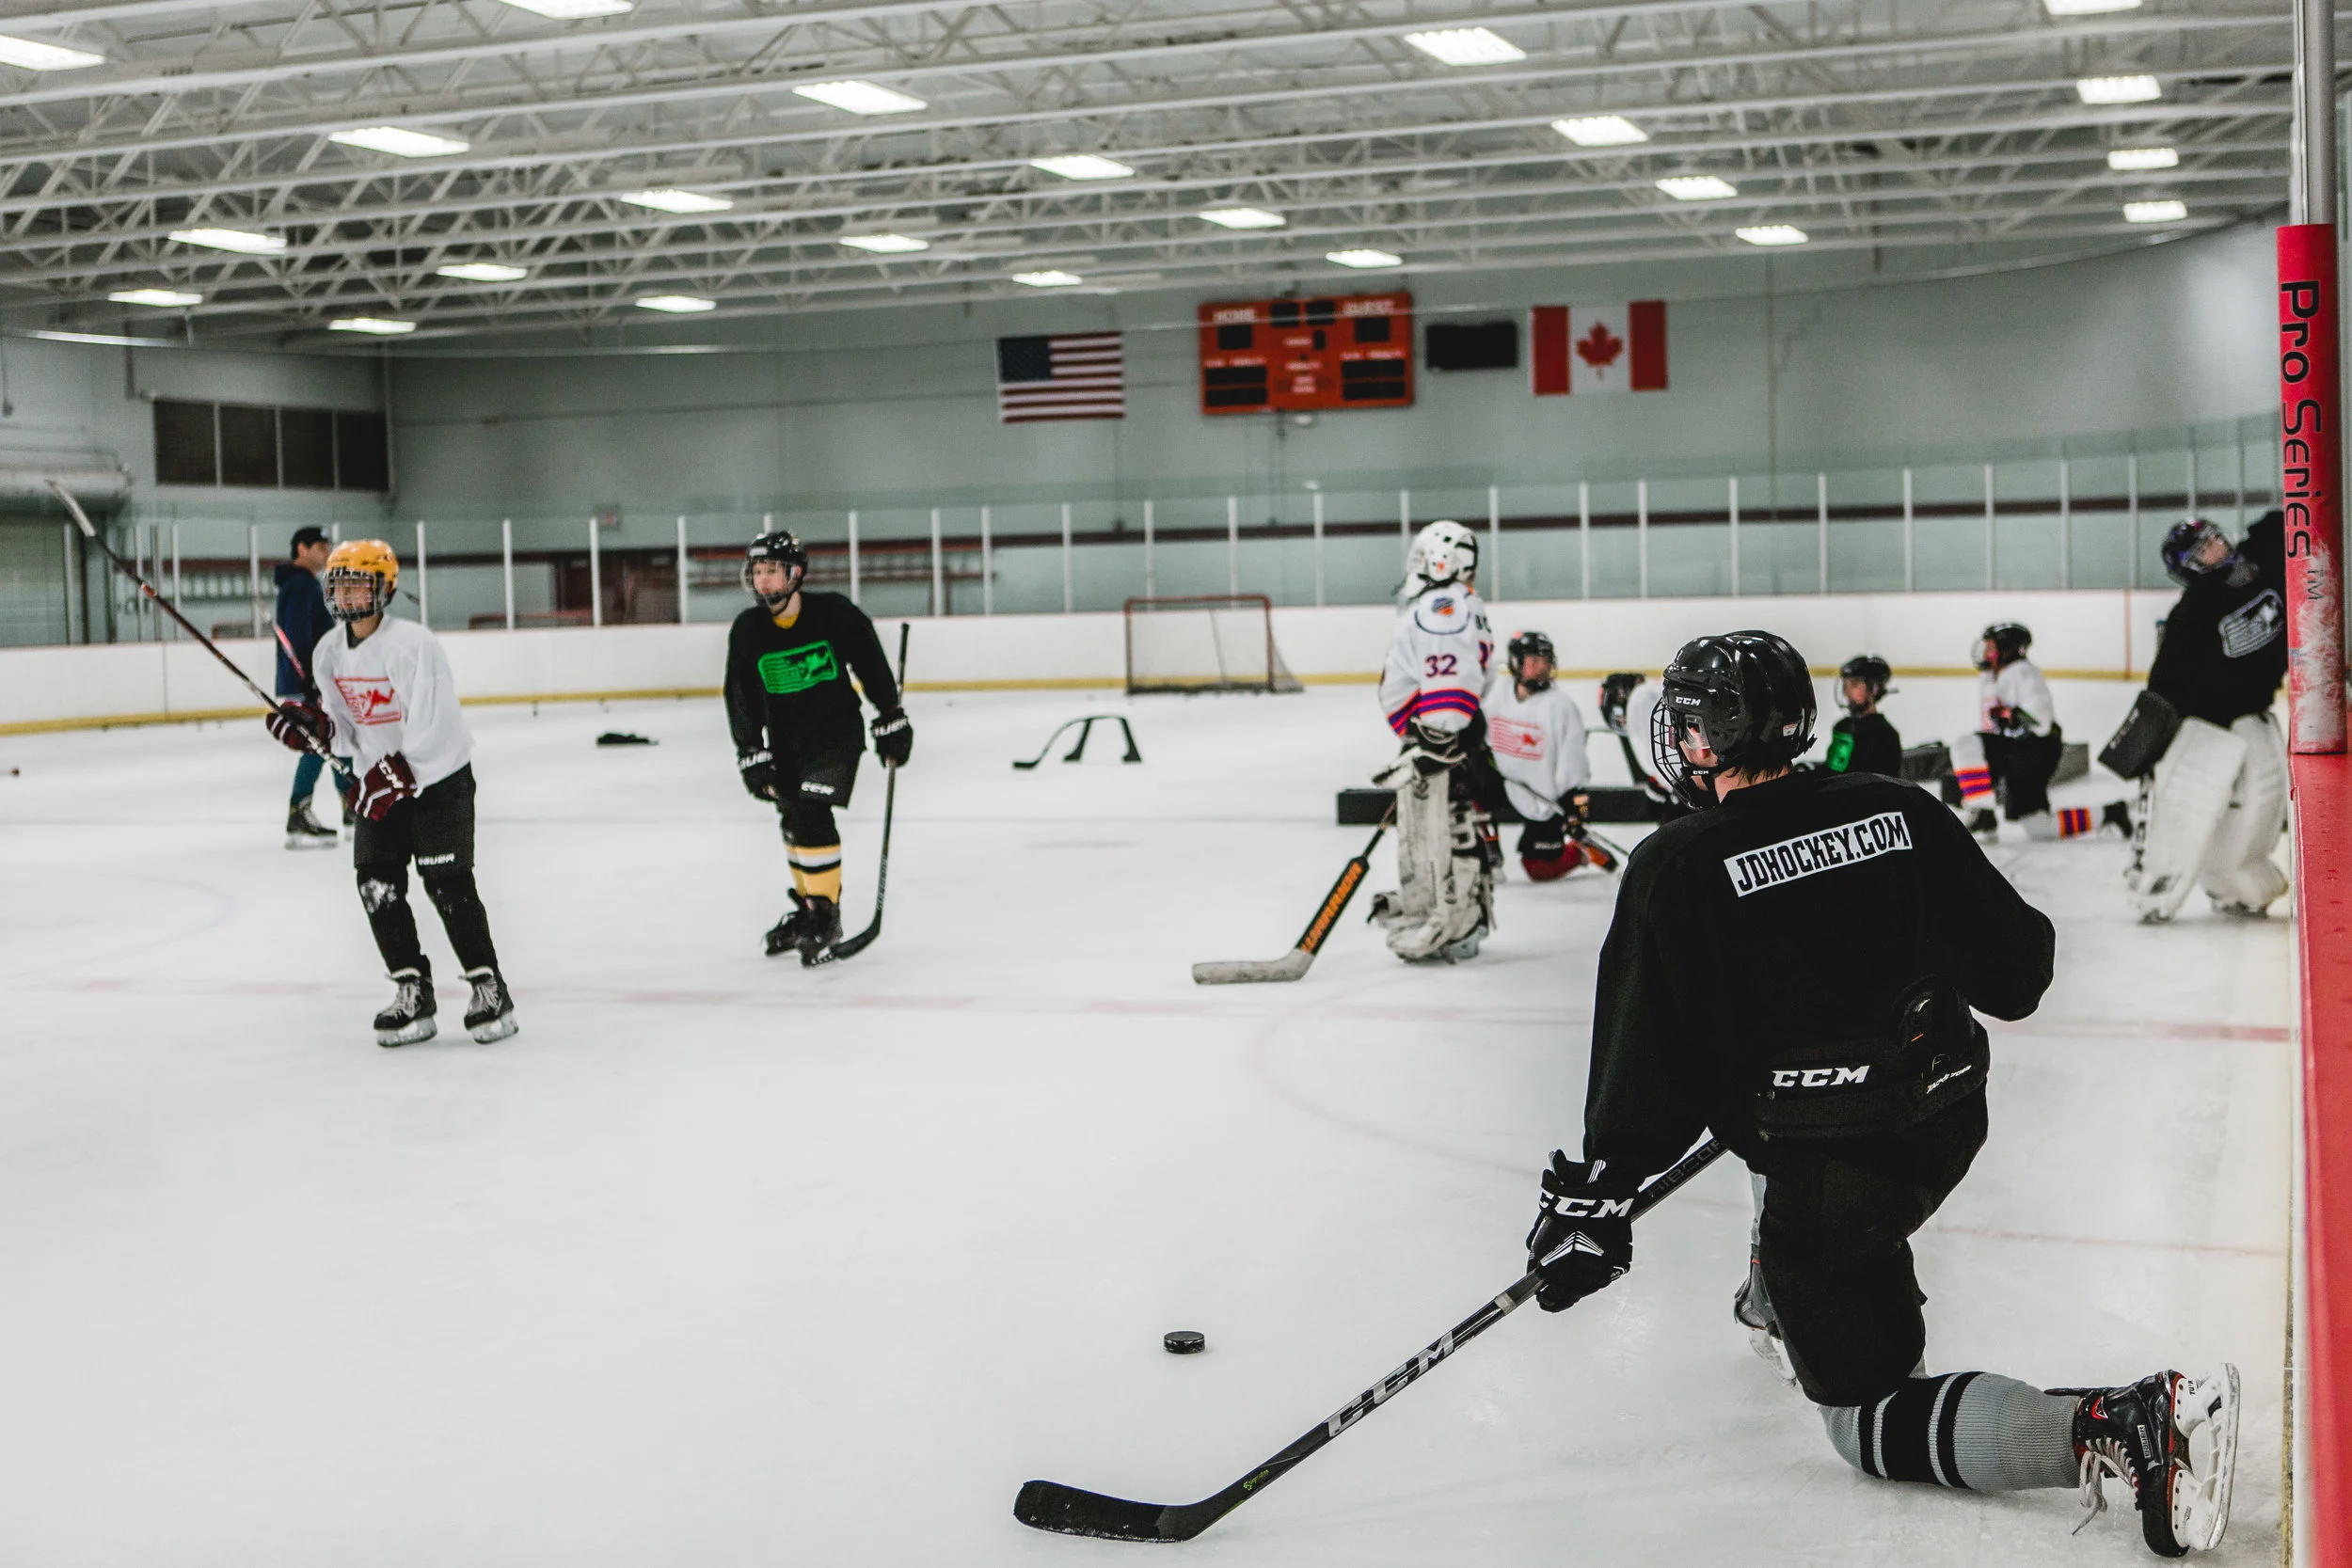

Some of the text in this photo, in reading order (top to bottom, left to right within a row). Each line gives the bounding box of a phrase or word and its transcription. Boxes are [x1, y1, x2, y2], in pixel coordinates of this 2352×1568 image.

[2280, 280, 2321, 384] Pro
[2282, 399, 2322, 559] Series
[1424, 654, 1457, 677] 32
[1676, 696, 1702, 706] CCM
[1736, 815, 1910, 893] JDHOCKEY.COM
[1772, 1065, 1870, 1087] CCM
[1537, 1188, 1634, 1218] CCM
[1326, 1330, 1455, 1438] CCM
